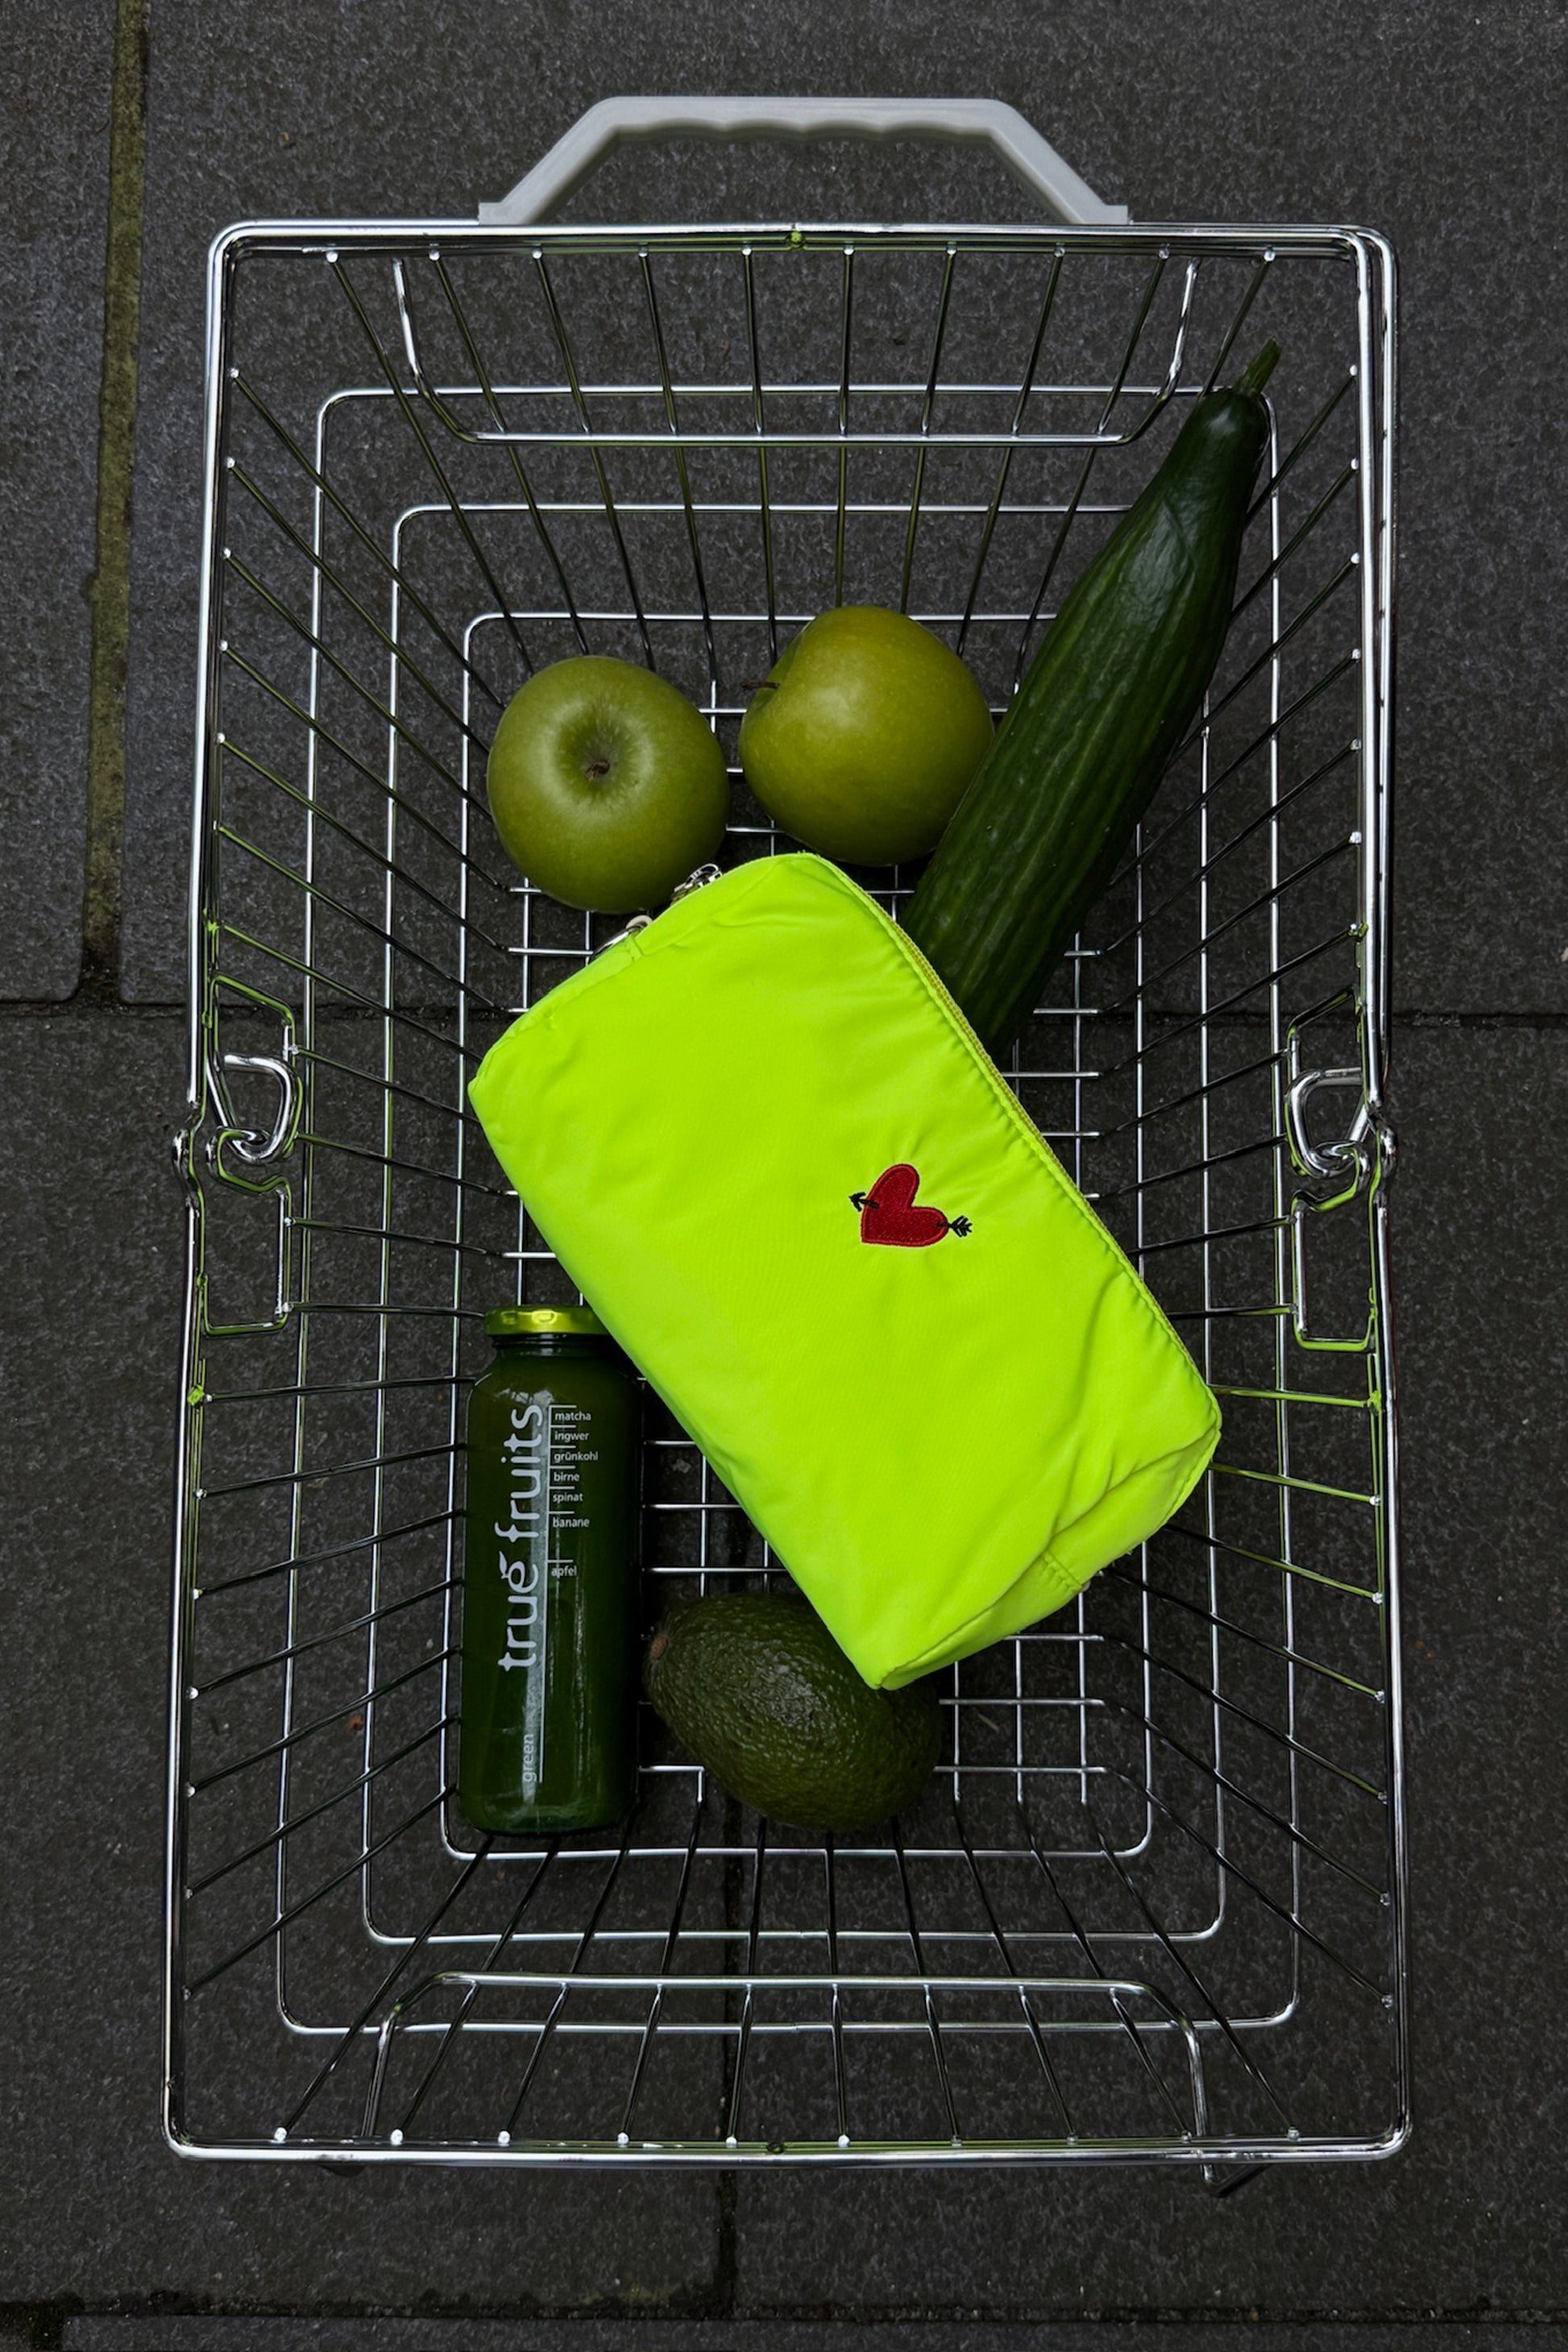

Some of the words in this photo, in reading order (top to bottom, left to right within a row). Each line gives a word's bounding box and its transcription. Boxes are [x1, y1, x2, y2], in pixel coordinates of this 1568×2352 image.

[554, 1410, 591, 1421] matcha
[554, 1430, 590, 1442] ingwer
[554, 1450, 599, 1462] grünkohl
[494, 1404, 544, 1543] fruits
[553, 1471, 580, 1482] birne
[552, 1492, 583, 1504] spinat
[552, 1517, 590, 1528] banane
[550, 1565, 577, 1577] apfel
[497, 1550, 539, 1672] true
[522, 1733, 535, 1782] green
